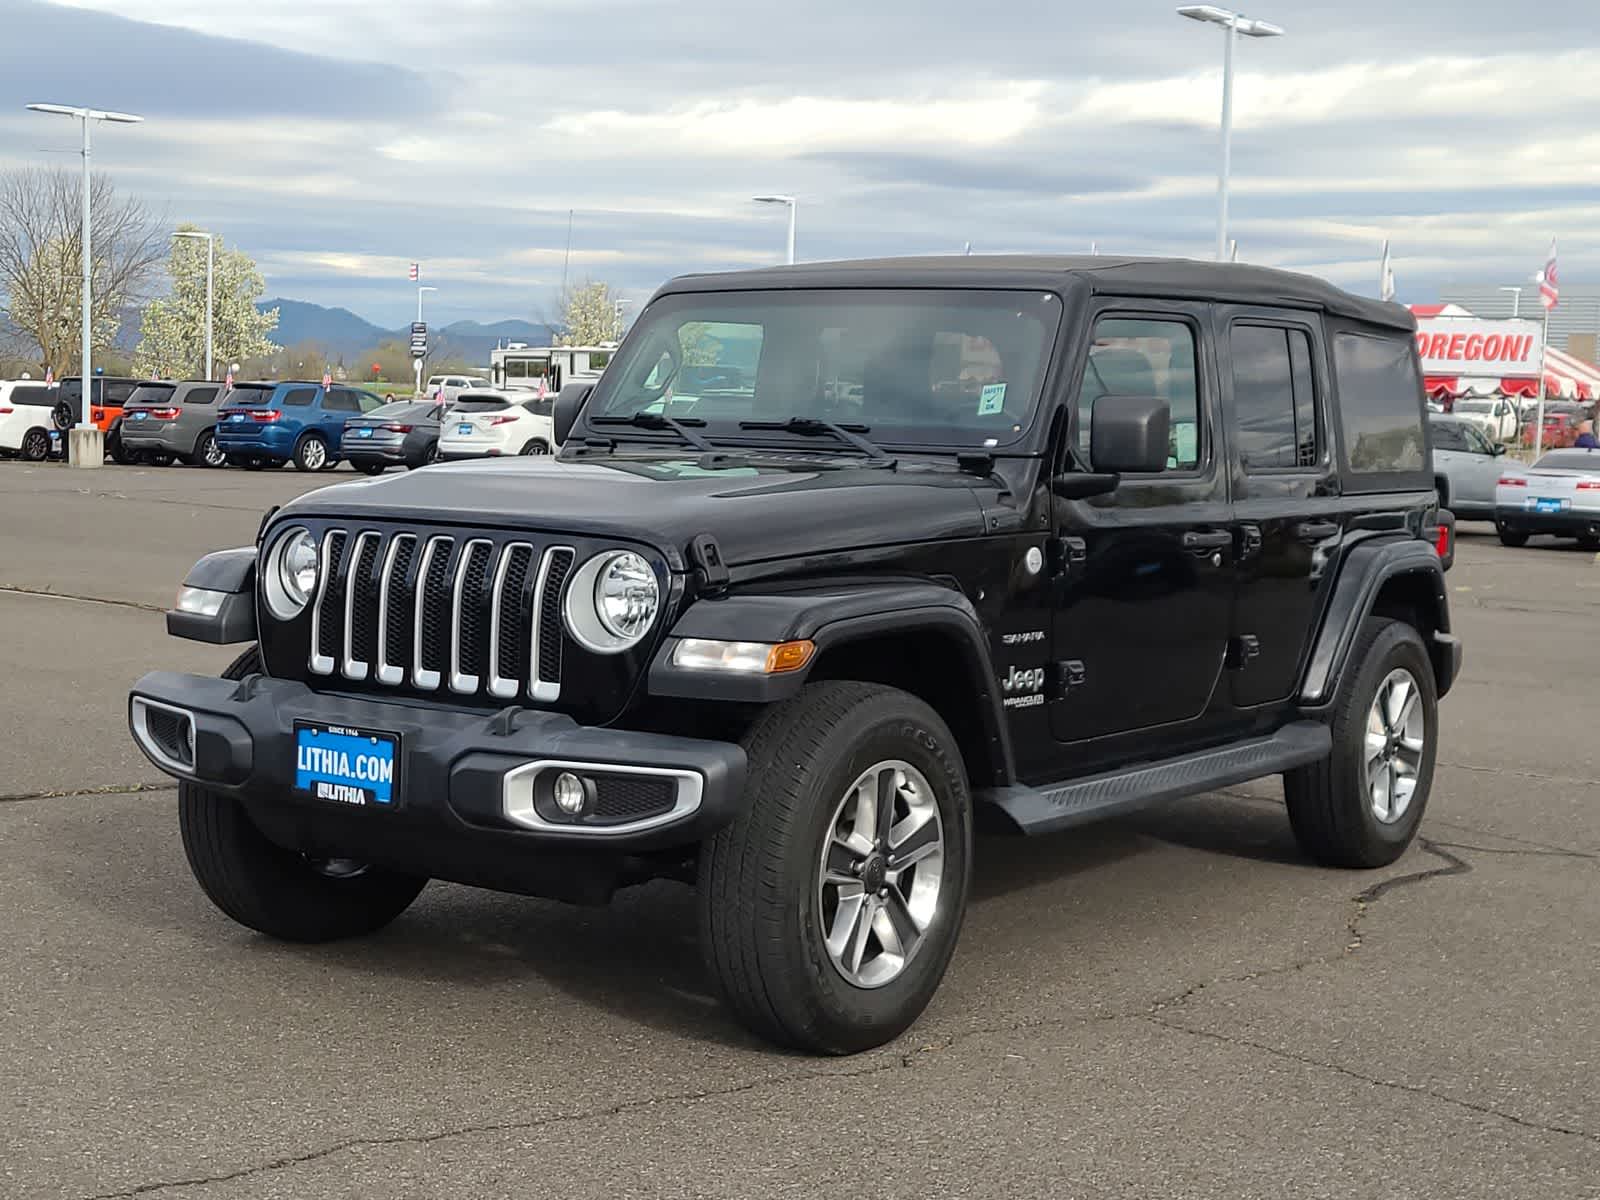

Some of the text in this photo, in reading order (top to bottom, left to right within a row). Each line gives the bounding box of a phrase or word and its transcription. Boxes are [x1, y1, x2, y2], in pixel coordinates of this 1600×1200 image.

[1416, 332, 1533, 361] OREGON!
[1002, 631, 1045, 643] SAHARA
[1002, 665, 1045, 691] Jeep
[298, 745, 394, 783] LITHIA.COM
[328, 783, 366, 805] LITHIA
